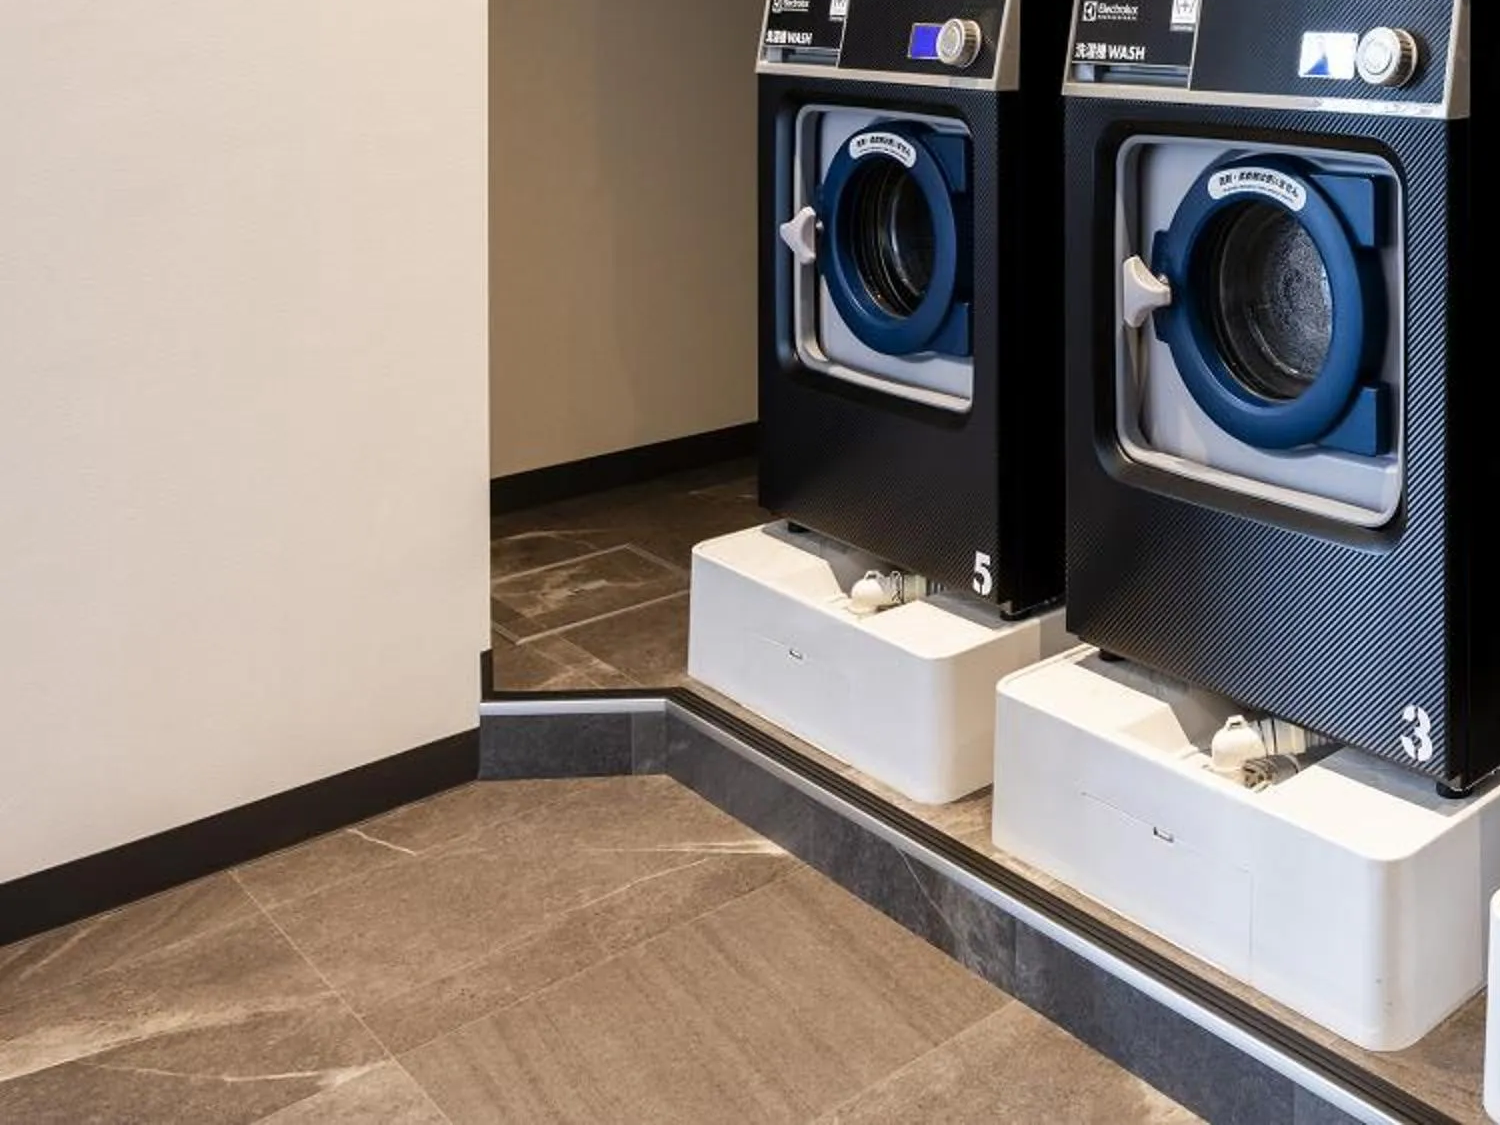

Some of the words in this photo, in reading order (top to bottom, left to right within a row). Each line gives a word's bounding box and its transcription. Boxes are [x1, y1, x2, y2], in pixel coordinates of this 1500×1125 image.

[1098, 2, 1139, 14] Electrolux
[1108, 44, 1146, 60] WASH
[973, 552, 993, 596] 5
[1402, 706, 1433, 763] 3
